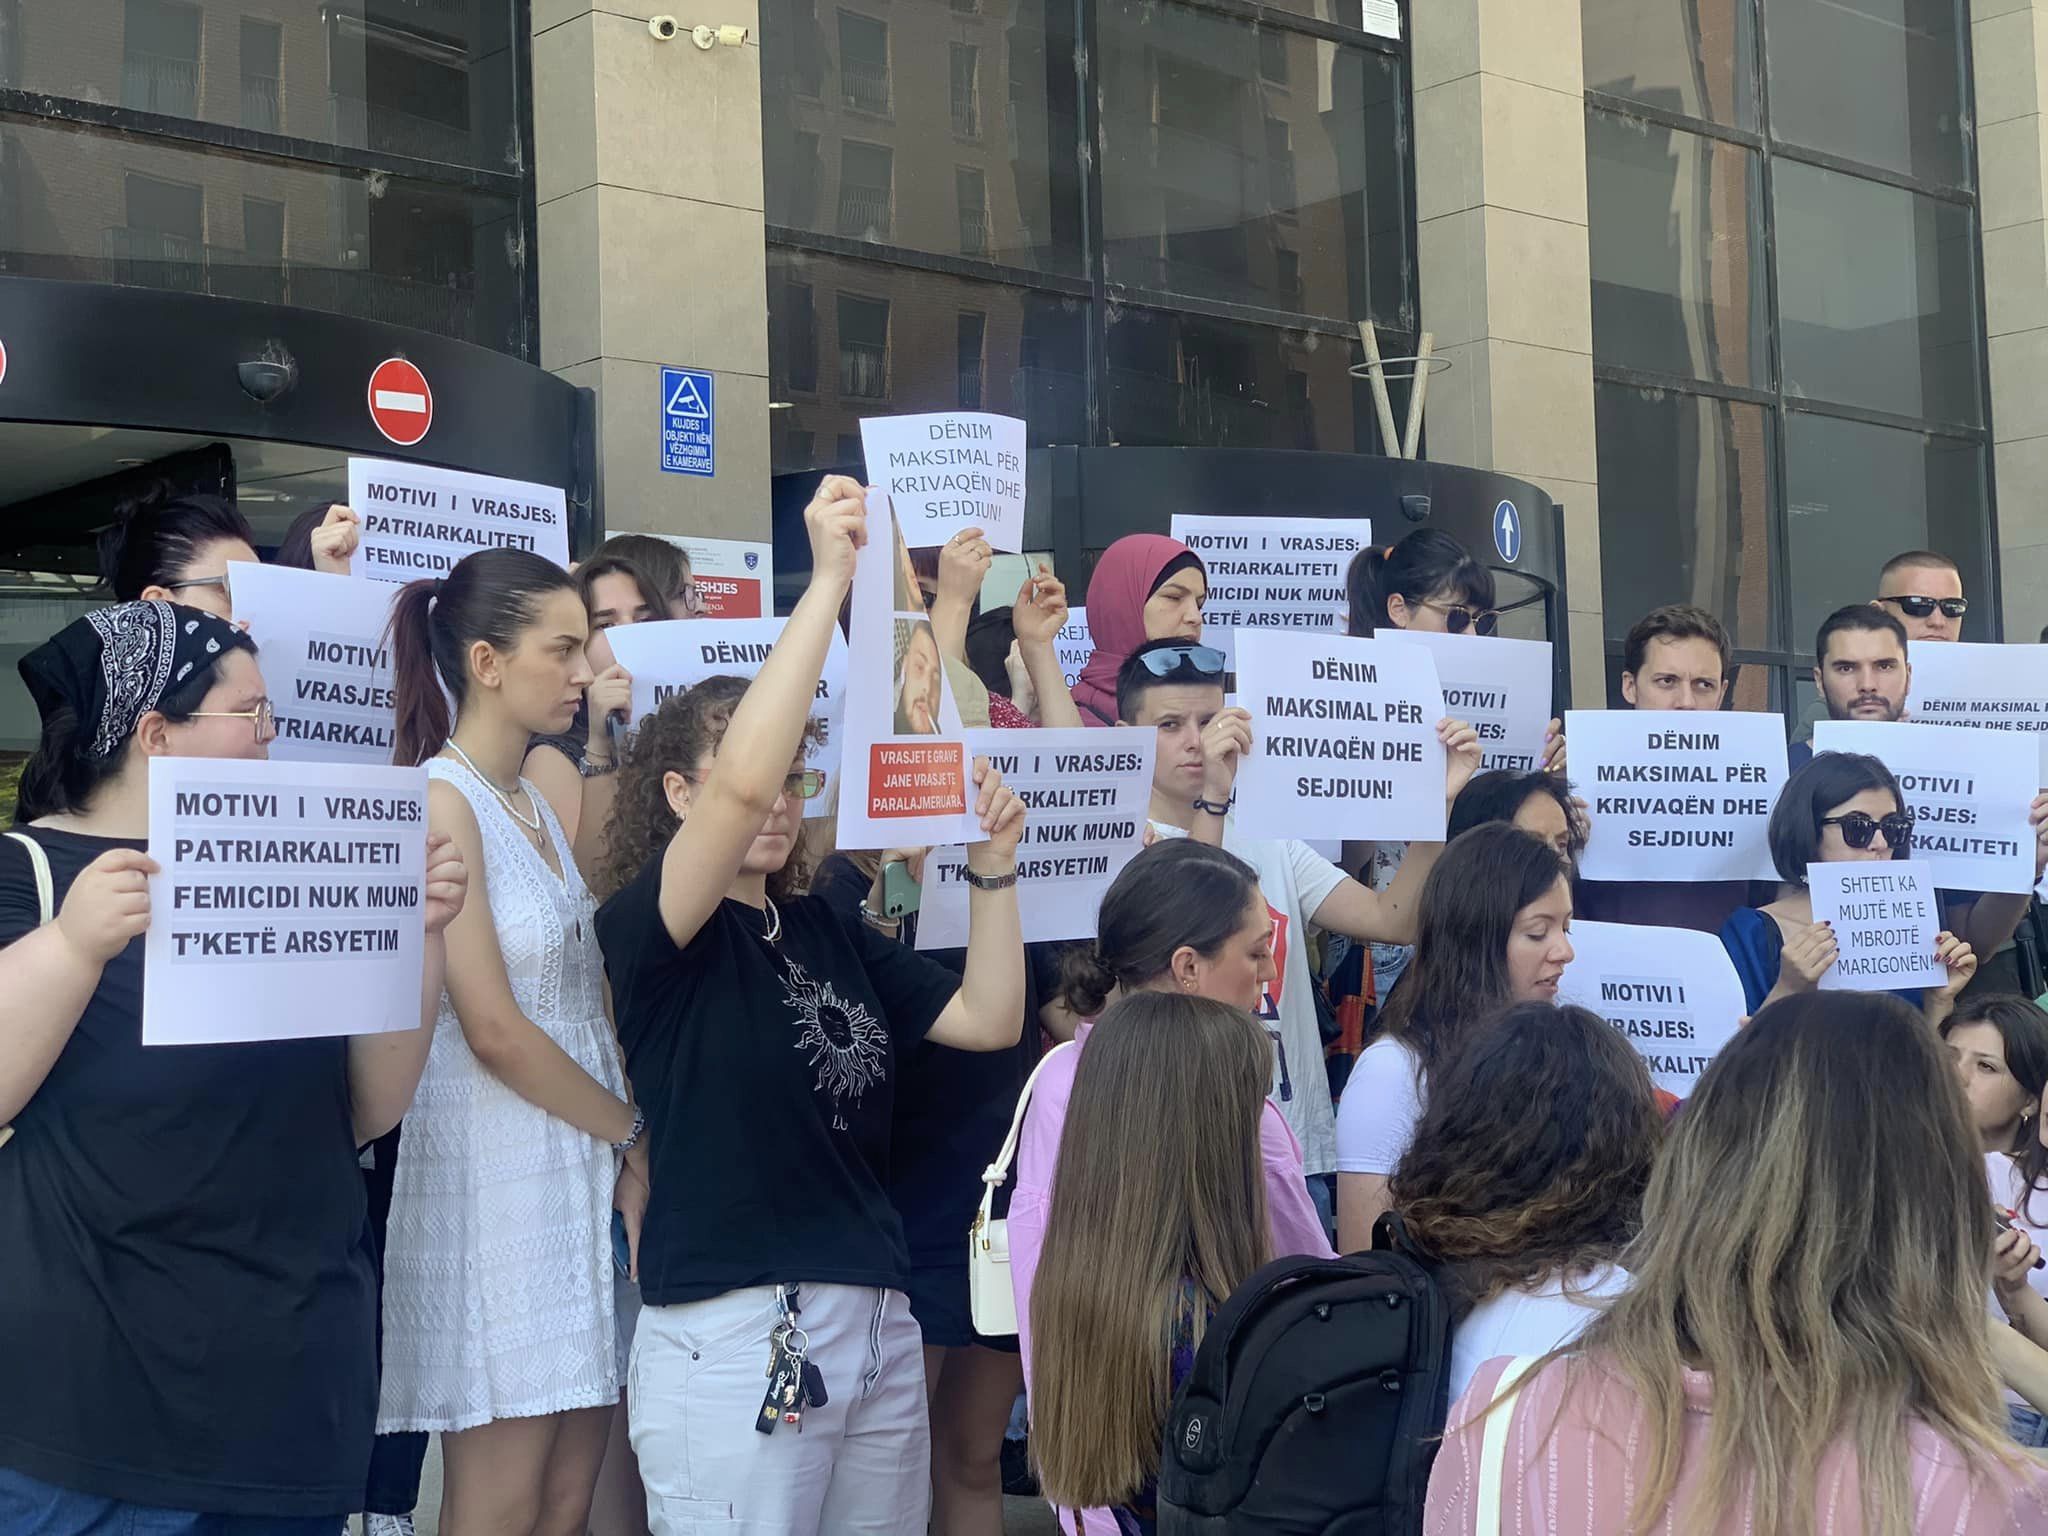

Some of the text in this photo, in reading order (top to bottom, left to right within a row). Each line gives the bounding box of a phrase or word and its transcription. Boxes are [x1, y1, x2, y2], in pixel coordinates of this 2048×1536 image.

[672, 416, 700, 431] KUJDES
[929, 420, 992, 440] DËNIM
[666, 430, 695, 443] OBJEKTI
[669, 443, 707, 457] VËZHGIMIN
[889, 449, 1020, 472] MAKSIMAL PËR
[667, 454, 711, 469] E KAMERAVE
[891, 471, 1020, 499] KRIVAQËN DHE
[367, 483, 557, 524] MOTIVI I VRASJES:
[925, 500, 1001, 522] SEJDIUN!
[365, 515, 535, 551] PATRIARKALITETI
[1185, 535, 1360, 551] MOTIVI I VRASJES:
[365, 546, 451, 571] FEMICIDI
[1207, 561, 1338, 577] TRIARKALITETI
[695, 581, 738, 594] ESHJES
[1206, 587, 1347, 602] MICIDI NUK MUN
[1201, 609, 1334, 626] KETË ARSYETIM
[307, 640, 387, 668] MOTIVI
[701, 641, 773, 664] DËNIM
[1312, 657, 1378, 683] DËNIM
[1267, 696, 1423, 724] MAKSIMAL PËR
[1500, 694, 1506, 709] I
[1922, 699, 1967, 712] DËNIM
[1970, 702, 2041, 713] MAKSIMAL
[273, 716, 394, 748] TRIARKALI
[1985, 720, 2012, 731] DHE
[2016, 721, 2048, 731] SEJD
[1266, 735, 1422, 762] KRIVAQËN DHE
[1648, 729, 1720, 750] DËNIM
[880, 750, 958, 765] VRASJET E GRAVE
[1034, 758, 1040, 773] I
[1055, 753, 1143, 773] VRASJES:
[883, 774, 911, 788] JANE
[1597, 763, 1768, 783] MAKSIMAL PËR
[1296, 777, 1393, 799] SEJDIUN!
[1896, 774, 1974, 795] OTIVI I
[176, 792, 422, 822] MOTIVI I VRASJES:
[1019, 788, 1116, 809] RKALITETI
[1596, 795, 1768, 816] KRIVAQËN DHE
[1906, 805, 1977, 825] ASJES:
[1036, 825, 1077, 844] NUK
[1083, 821, 1136, 841] MUND
[1628, 830, 1734, 847] SEJDIUN!
[175, 839, 400, 864] PATRIARKALITETI
[1910, 834, 2018, 857] RKALITETI
[1016, 856, 1109, 879] ARSYETIM
[1840, 875, 1917, 894] SHTETI KA
[174, 886, 418, 909] FEMICIDI NUK MUND
[1839, 899, 1926, 921] MUJTË ME E
[171, 926, 398, 956] T’KETË ARSYETIM
[1851, 925, 1920, 948] MBROJTË
[1837, 952, 1934, 977] MARIGONËN!
[1601, 982, 1685, 1003] MOTIVI I
